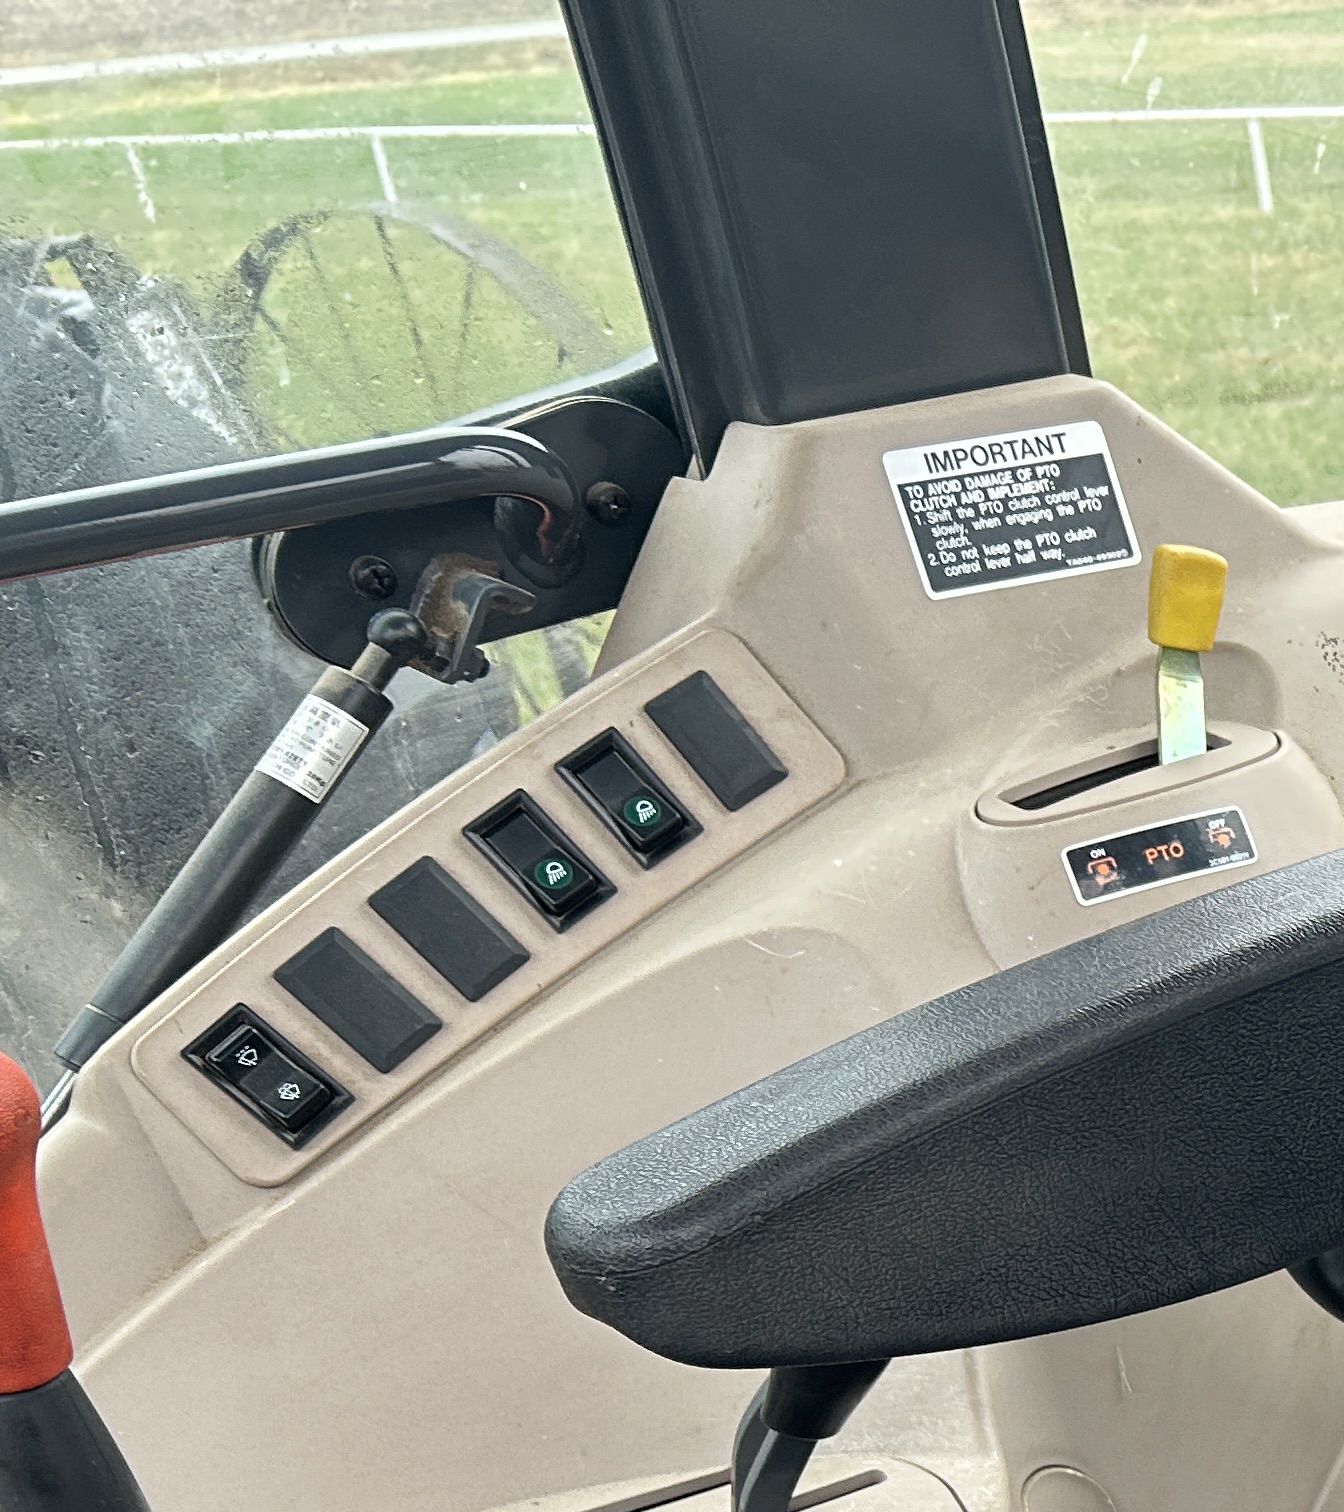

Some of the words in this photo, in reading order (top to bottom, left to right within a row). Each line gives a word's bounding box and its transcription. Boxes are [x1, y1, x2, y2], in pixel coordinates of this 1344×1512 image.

[923, 432, 1067, 474] IMPORTANT
[904, 485, 925, 499] TO
[927, 479, 963, 497] AVOID
[963, 470, 1015, 490] DAMAGE
[1016, 467, 1033, 482] OF
[1035, 463, 1061, 479] PTO
[910, 494, 958, 513] CLUTCH
[960, 489, 985, 504] AND
[986, 479, 1056, 501] IMPLEMENT:
[931, 521, 969, 538] slowly,
[971, 517, 1002, 531] when
[1005, 508, 1054, 526] engaging
[1056, 504, 1076, 517] the
[1077, 497, 1102, 514] PTO
[956, 506, 976, 519] the
[978, 500, 1004, 515] PTO
[1008, 495, 1042, 511] clutch
[1044, 488, 1081, 505] control
[1083, 485, 1109, 499] lever
[935, 535, 973, 551] clutch.
[961, 546, 980, 560] not
[982, 542, 1011, 557] keep
[1013, 538, 1033, 552] the
[1035, 531, 1061, 548] PTO
[1064, 526, 1098, 543] clutch
[944, 559, 983, 577] control
[984, 556, 1012, 570] lever
[1014, 549, 1037, 564] half
[1040, 547, 1066, 561] way.
[1089, 847, 1107, 859] ON
[1144, 841, 1185, 865] PTO
